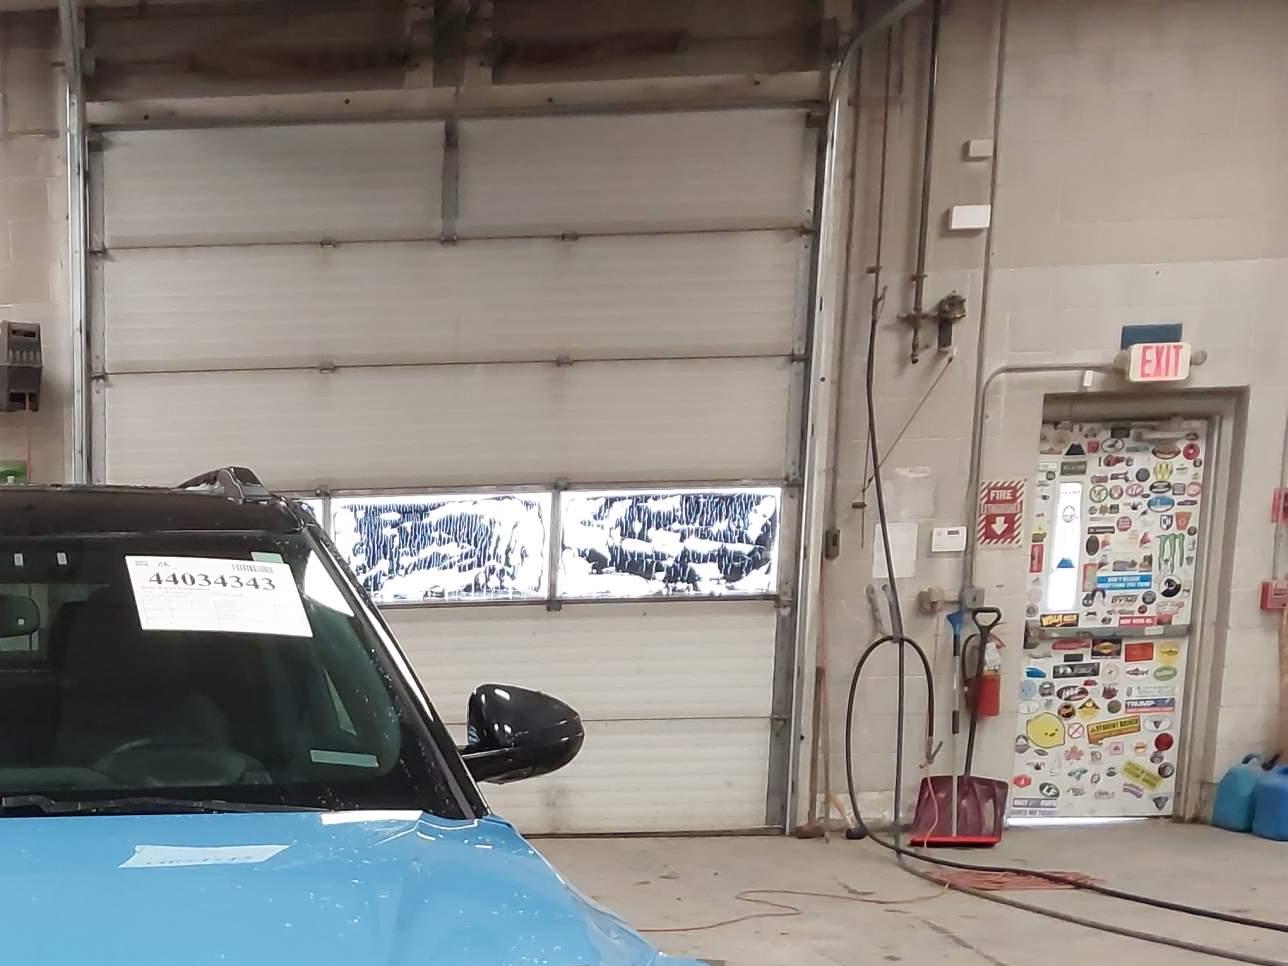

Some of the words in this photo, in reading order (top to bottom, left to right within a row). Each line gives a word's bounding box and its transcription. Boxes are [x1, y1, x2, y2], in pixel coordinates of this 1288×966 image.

[1140, 344, 1183, 378] EXIT
[990, 489, 1013, 501] FIRE
[148, 571, 276, 591] 44034343
